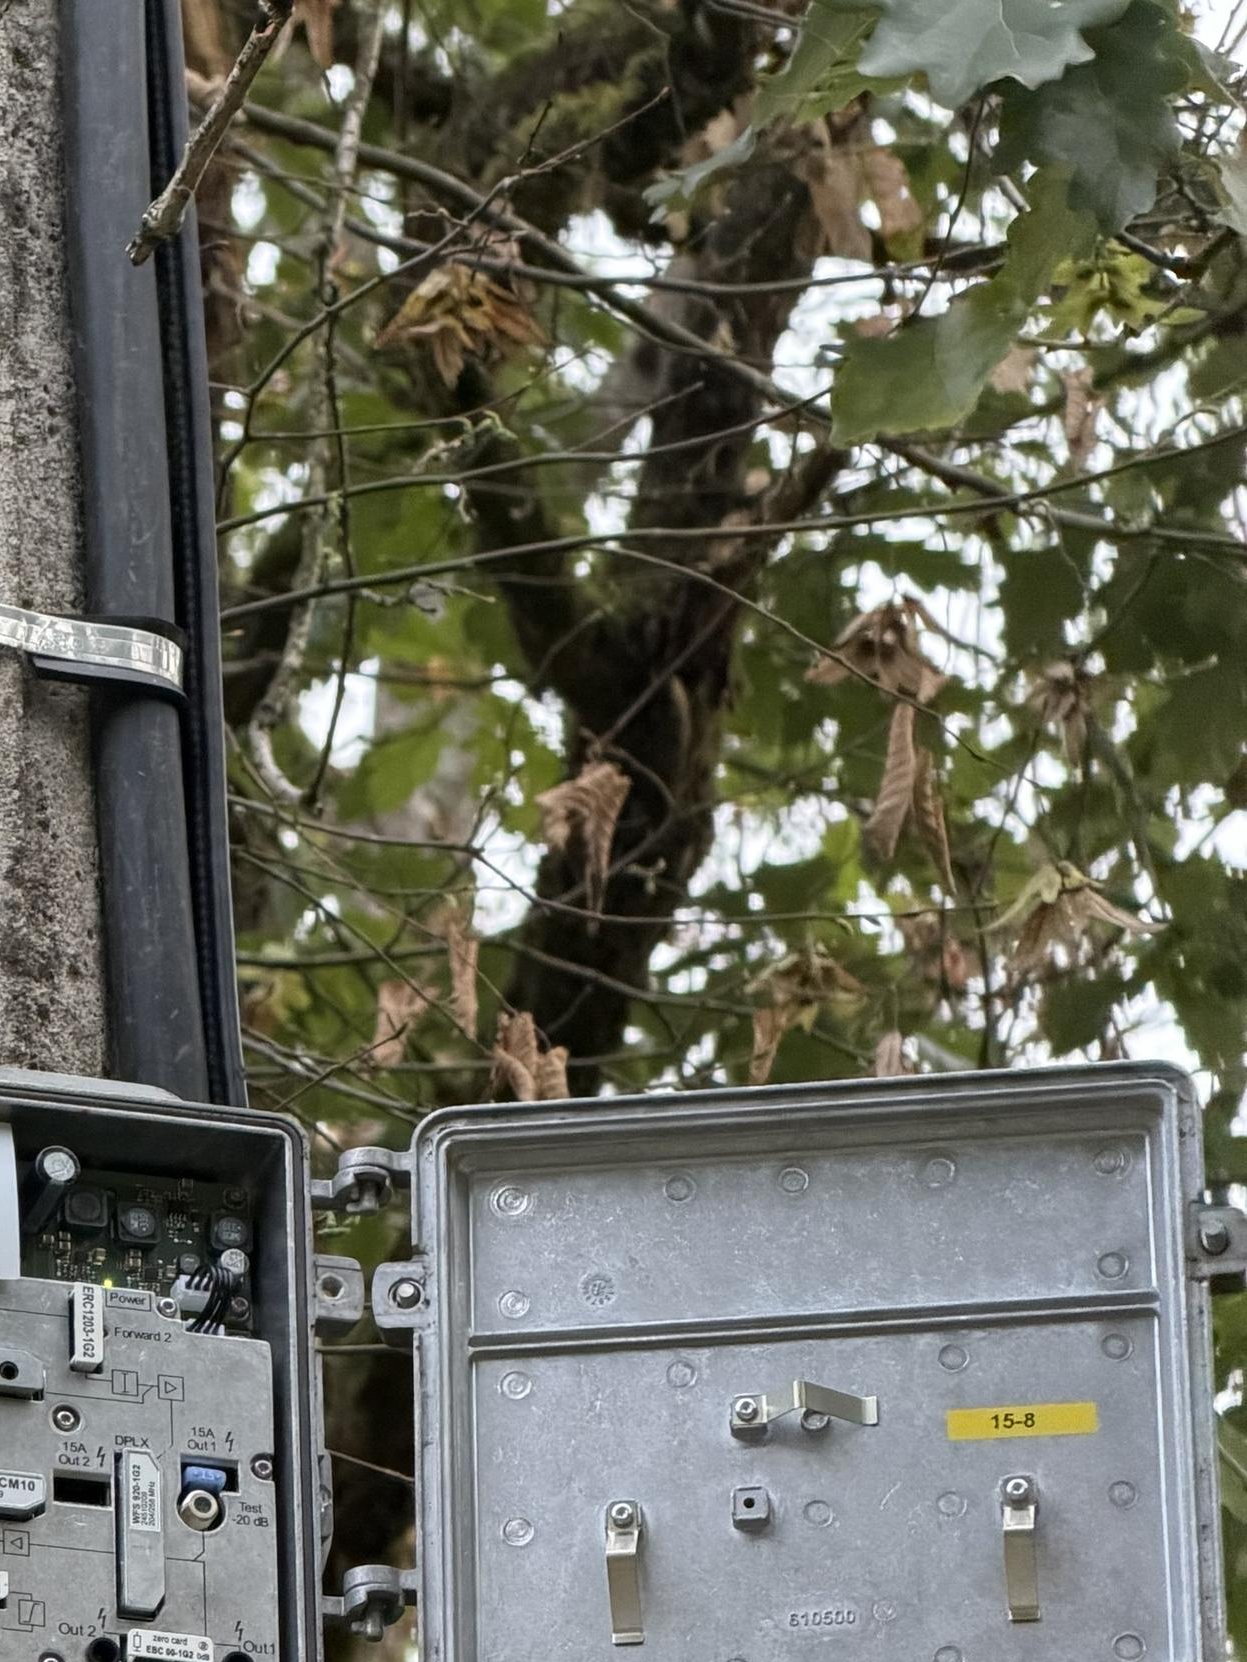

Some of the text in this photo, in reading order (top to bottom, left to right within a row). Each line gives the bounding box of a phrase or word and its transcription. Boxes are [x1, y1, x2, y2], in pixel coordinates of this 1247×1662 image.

[110, 1292, 146, 1305] Power
[82, 1286, 95, 1358] ERC1203-1G2
[114, 1326, 172, 1343] Forward 2
[990, 1412, 1035, 1430] 15-8
[190, 1427, 215, 1439] 15A
[63, 1441, 87, 1454] 15A
[115, 1434, 149, 1448] DPLX
[187, 1439, 208, 1451] Out
[58, 1453, 90, 1467] Out 2
[132, 1503, 141, 1524] WFS
[239, 1502, 262, 1514] Test
[233, 1514, 269, 1528] -20 dB
[789, 1610, 856, 1628] 610500
[58, 1622, 97, 1638] Out 2
[153, 1634, 170, 1643] zero
[171, 1637, 188, 1646] card
[243, 1640, 268, 1654] Out
[146, 1645, 164, 1655] EBC
